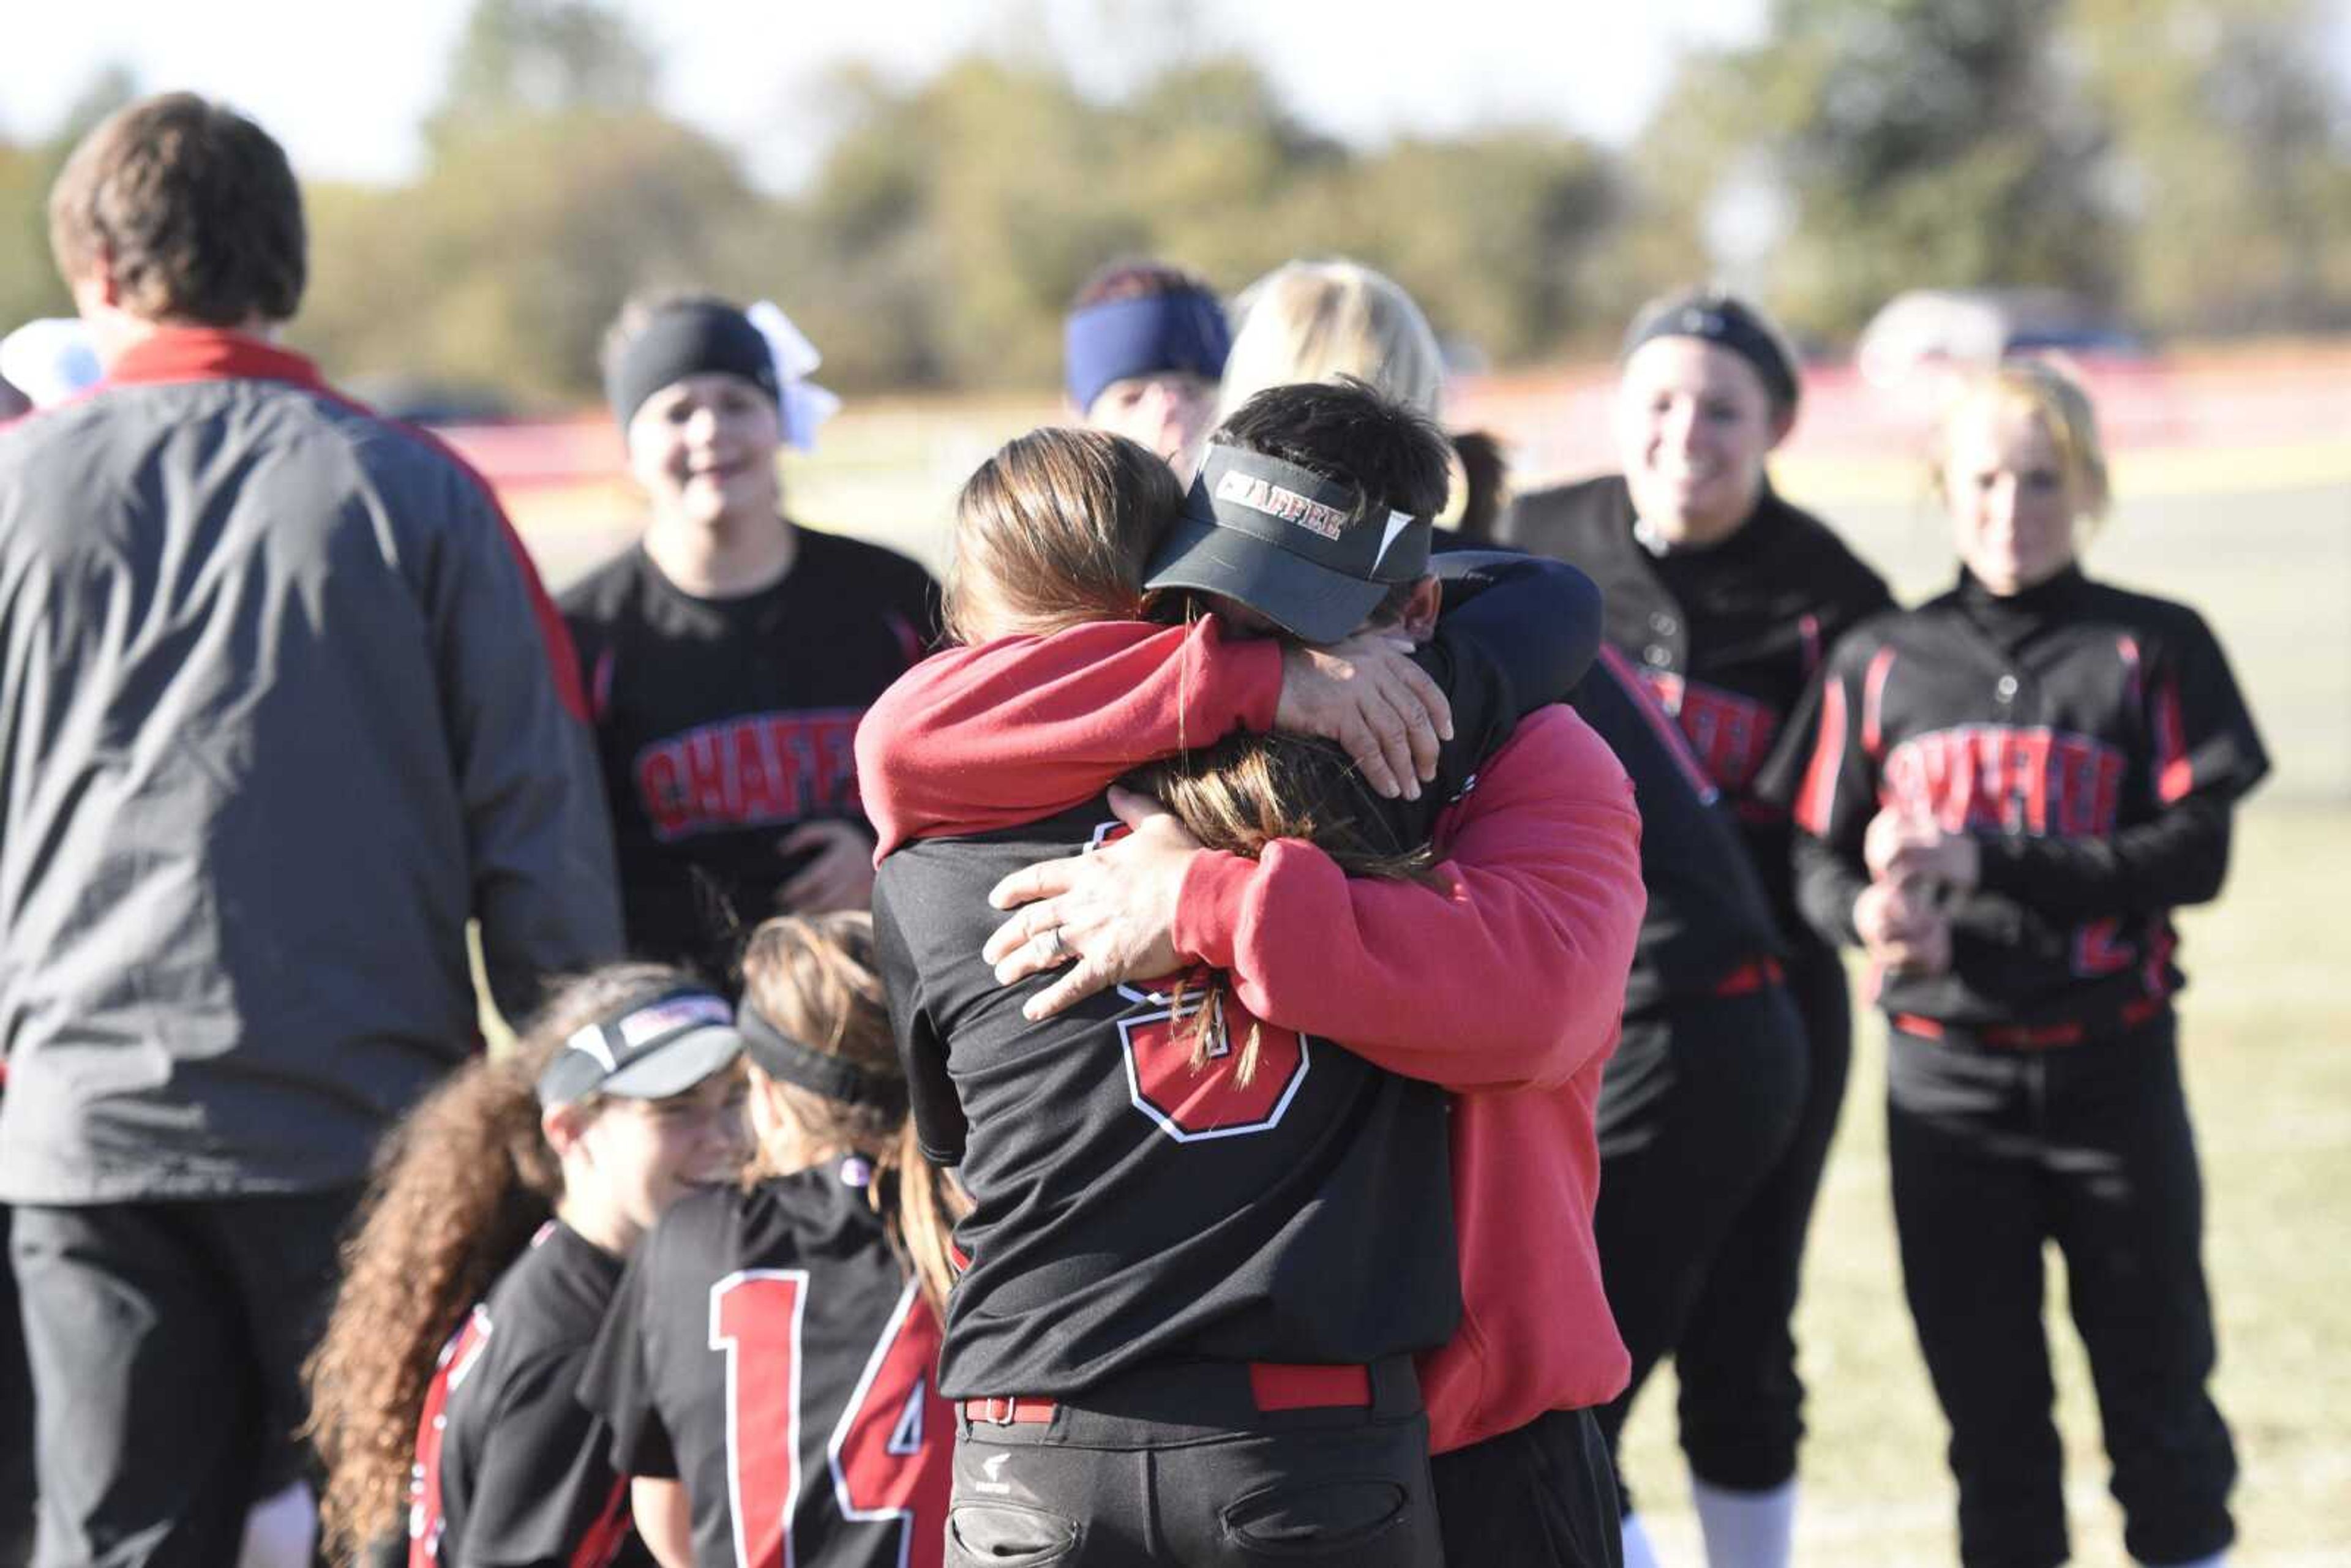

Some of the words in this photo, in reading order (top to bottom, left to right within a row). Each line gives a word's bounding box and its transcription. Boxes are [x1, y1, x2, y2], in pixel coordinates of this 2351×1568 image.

[1215, 469, 1347, 542] CHAFFEE
[636, 705, 864, 841] CHAFF
[708, 1269, 956, 1568] 14
